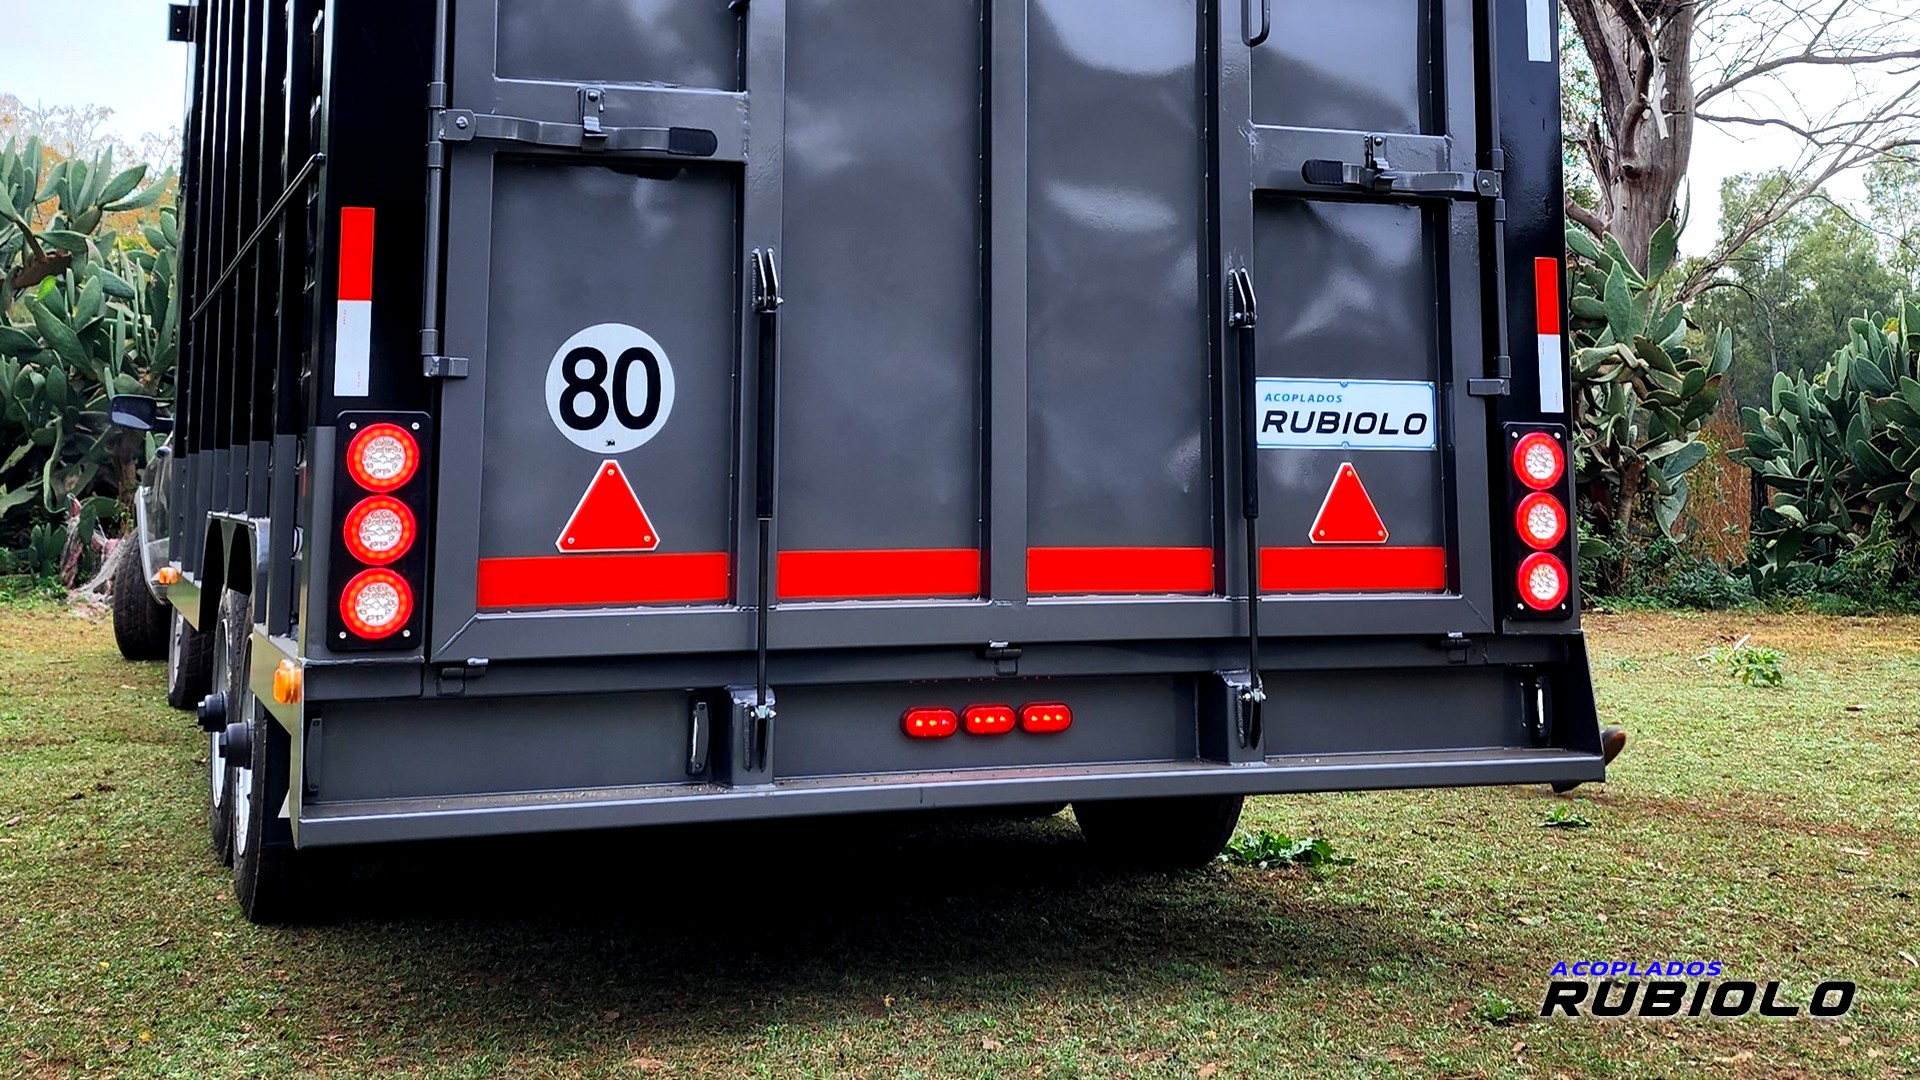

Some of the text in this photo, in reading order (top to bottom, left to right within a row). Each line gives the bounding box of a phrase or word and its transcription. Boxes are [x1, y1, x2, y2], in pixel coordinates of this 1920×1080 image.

[559, 346, 661, 430] 80
[1264, 393, 1343, 403] ACOPLADOS
[1261, 410, 1428, 435] RUBIOLO
